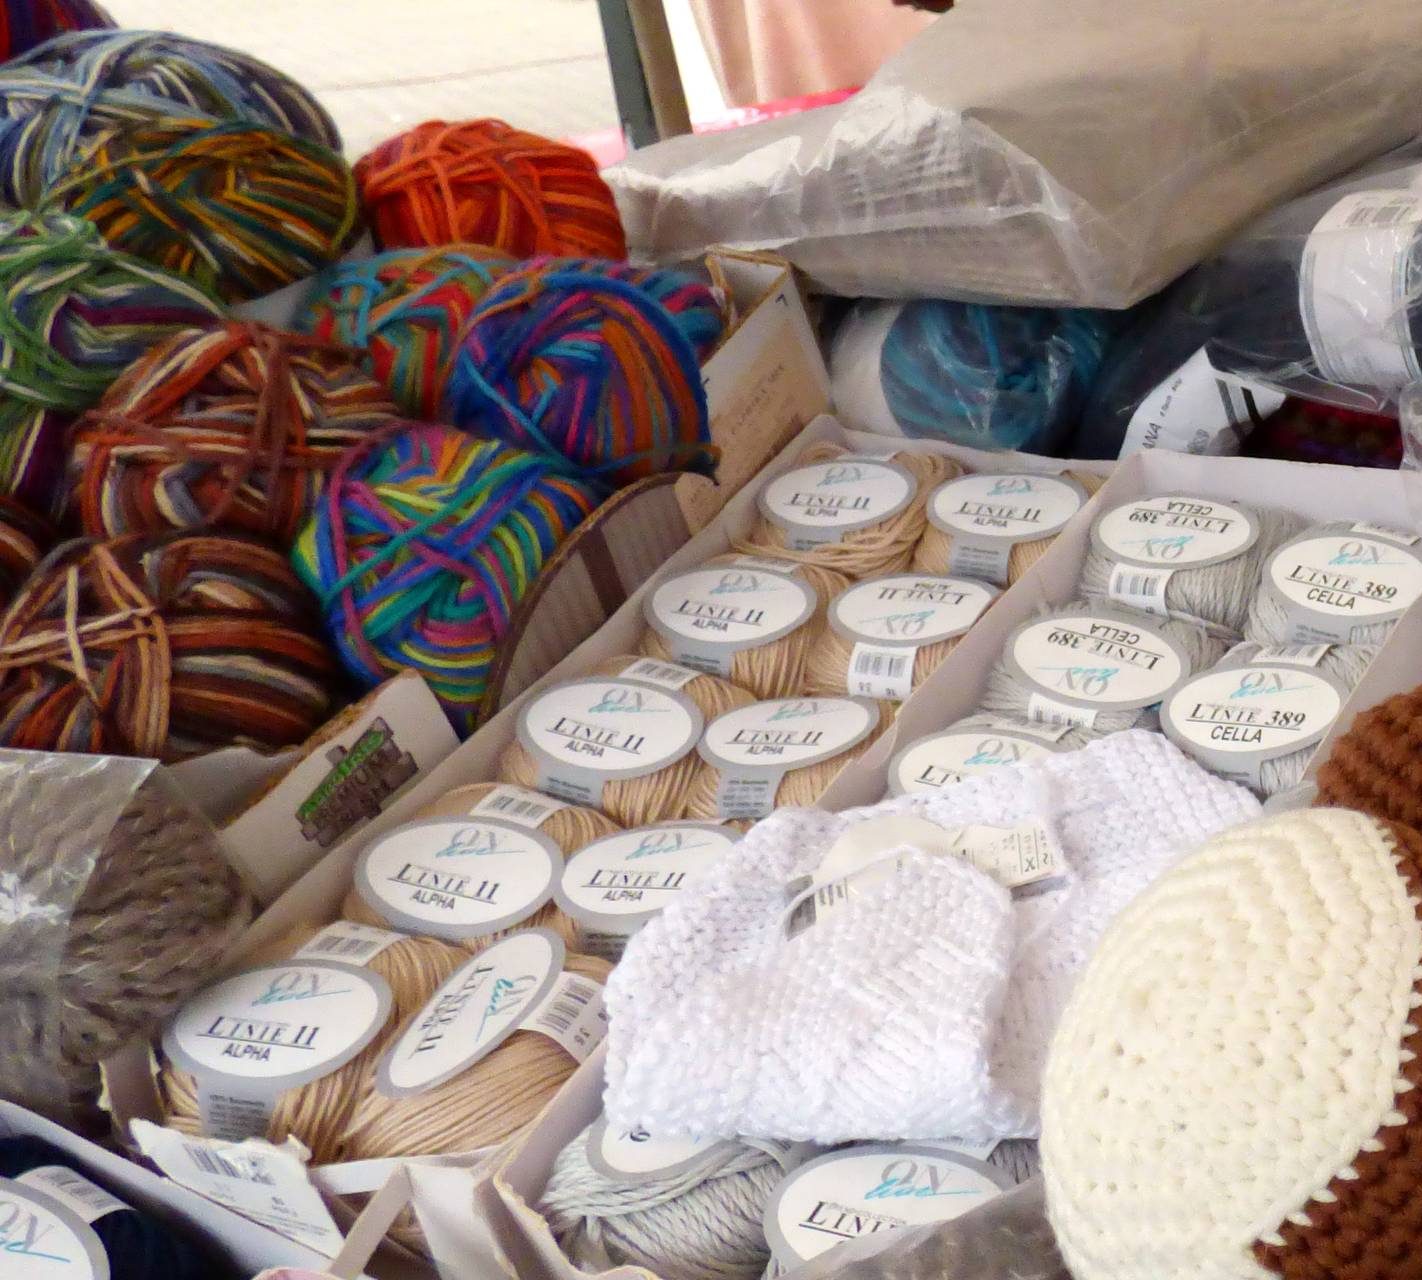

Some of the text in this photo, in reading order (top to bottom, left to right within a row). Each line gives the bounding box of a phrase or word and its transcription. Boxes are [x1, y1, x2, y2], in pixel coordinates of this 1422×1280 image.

[804, 508, 838, 518] ALPHA
[1167, 501, 1213, 516] CELLA
[973, 517, 1009, 528] ALPHA
[1129, 511, 1158, 525] 389
[1307, 588, 1356, 609] CELLA
[1359, 581, 1398, 600] 389
[692, 619, 729, 632] ALPHA
[1089, 623, 1140, 644] CELLA
[1047, 631, 1087, 650] 389
[1265, 711, 1307, 728] 389
[1211, 725, 1263, 744] CELLA
[565, 740, 605, 758] ALPHA
[745, 745, 785, 756] ALPHA
[412, 891, 456, 910] ALPHA
[602, 889, 643, 902] ALPHA
[221, 1043, 271, 1062] ALPHA
